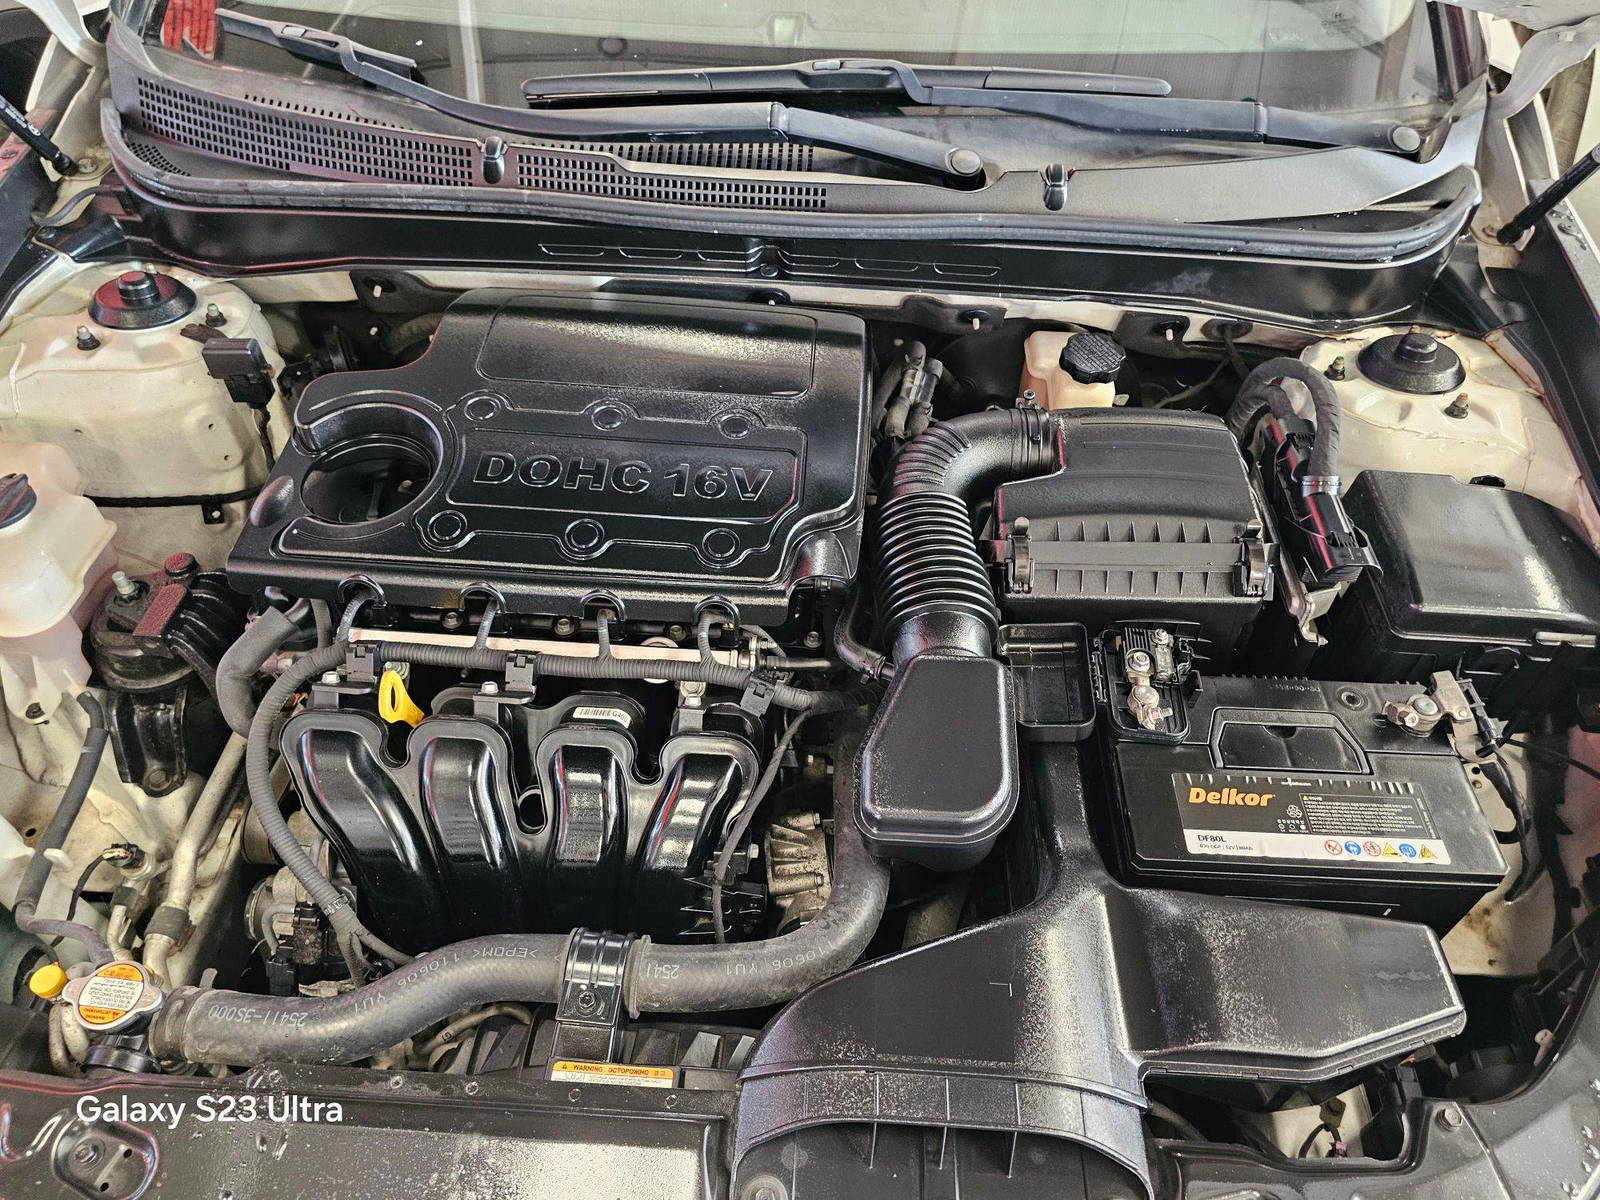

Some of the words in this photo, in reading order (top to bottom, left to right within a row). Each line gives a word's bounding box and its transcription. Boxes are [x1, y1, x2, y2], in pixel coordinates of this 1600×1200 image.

[473, 452, 652, 494] DOHC
[664, 463, 774, 501] 16V
[1188, 787, 1273, 807] Delkor
[1197, 834, 1227, 843] DF80L
[207, 1004, 309, 1028] 25411-3S000
[573, 1064, 603, 1073] WARNING
